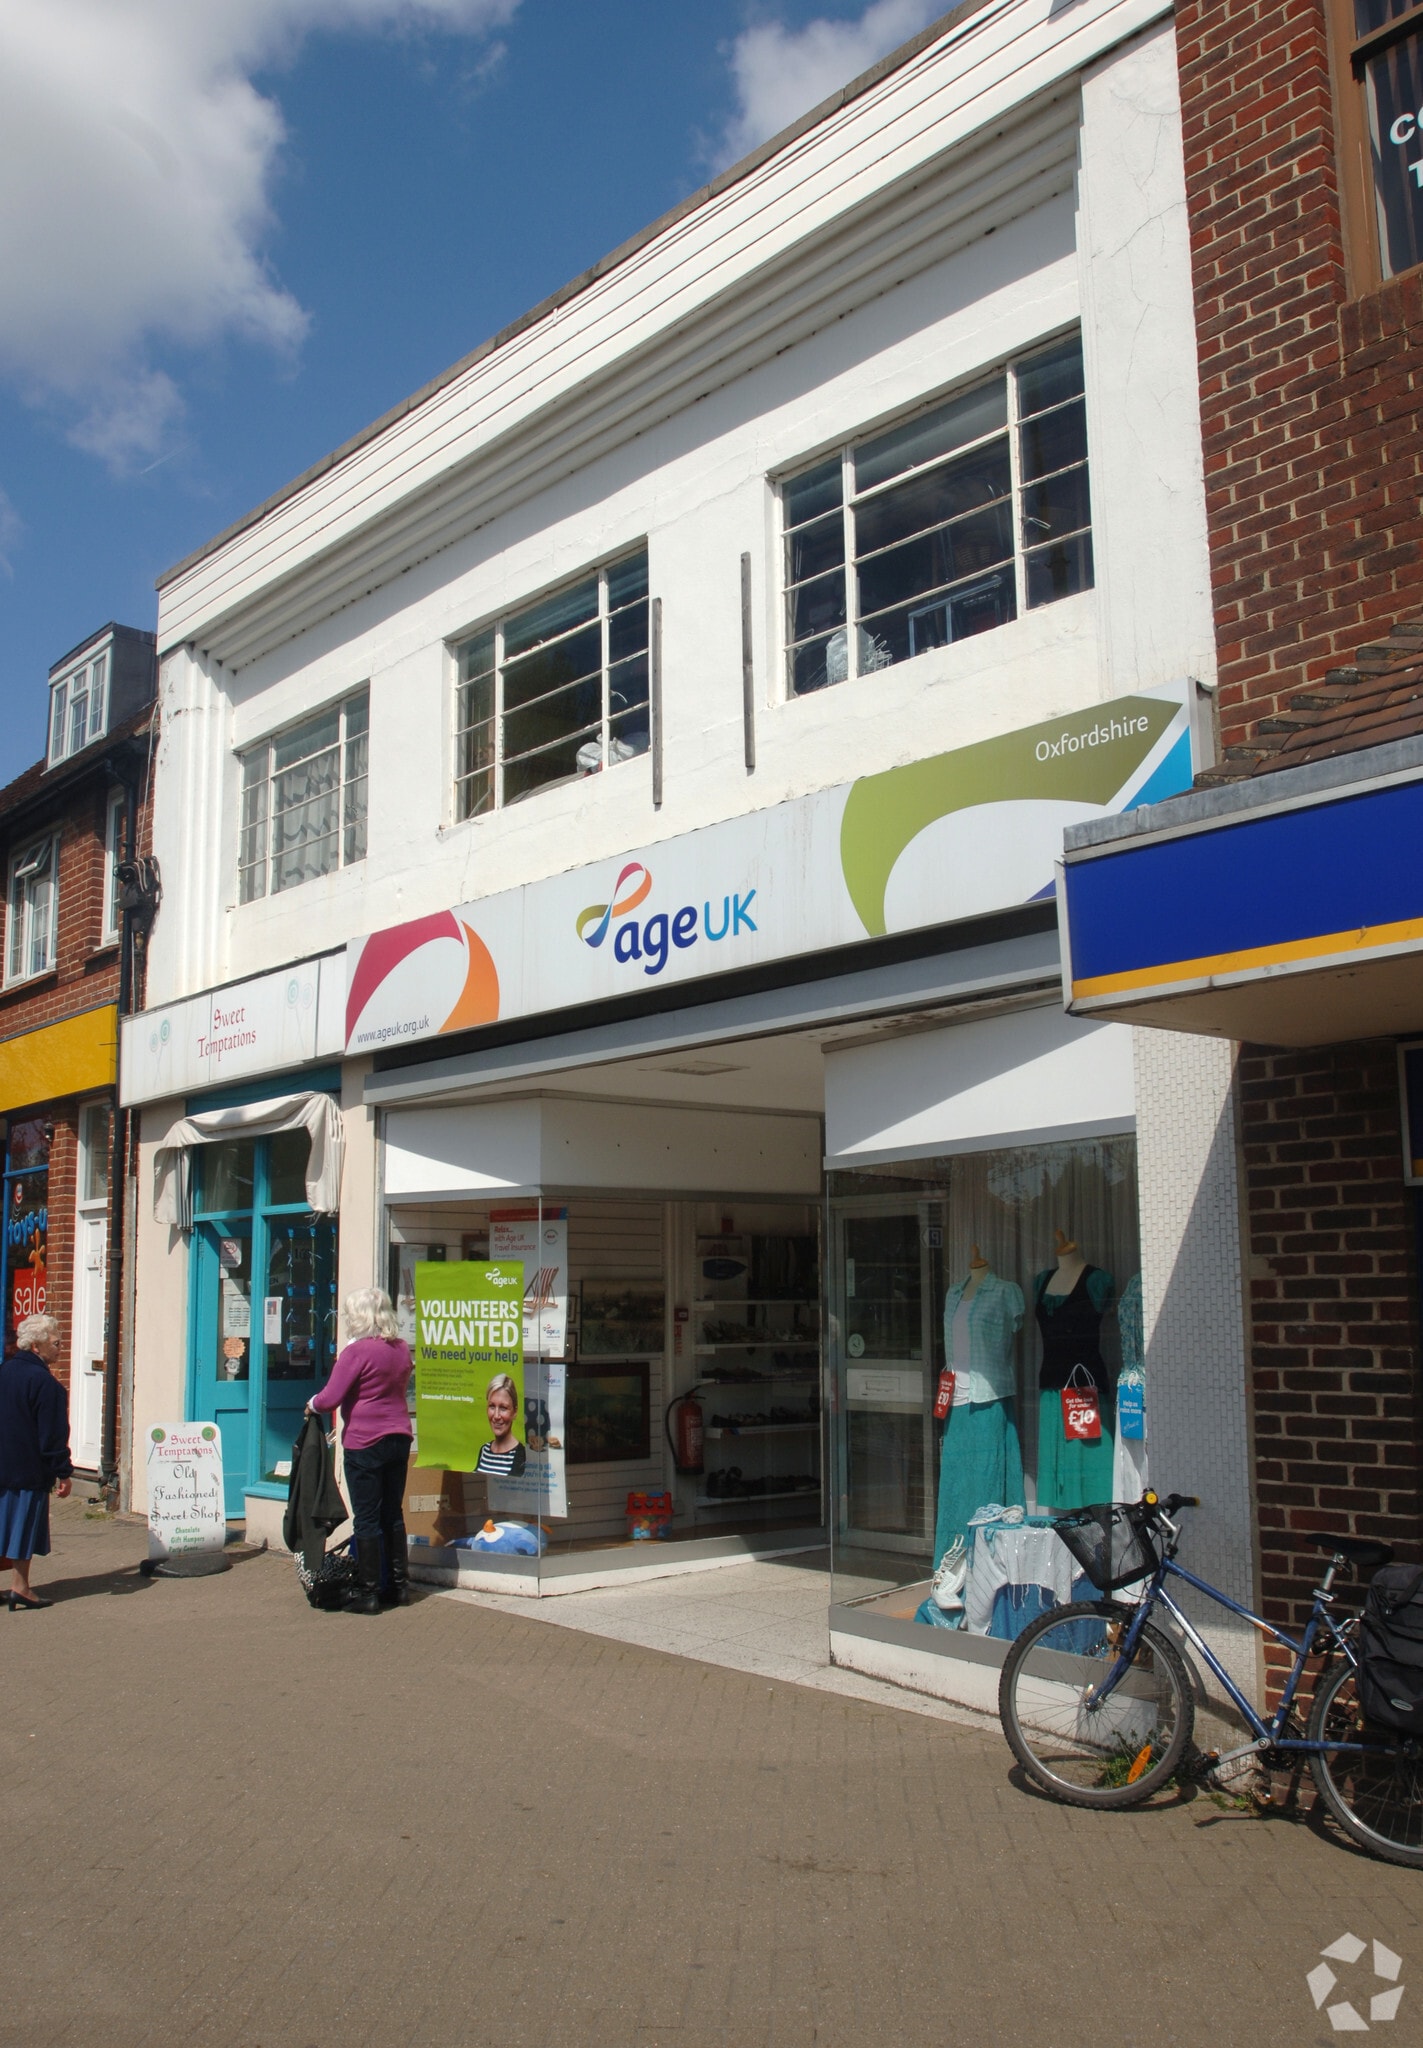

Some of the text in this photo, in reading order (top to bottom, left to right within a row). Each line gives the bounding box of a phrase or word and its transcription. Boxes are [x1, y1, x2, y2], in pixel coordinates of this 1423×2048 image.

[1035, 715, 1149, 762] Oxfordshire
[213, 1006, 246, 1031] Sweet
[357, 1015, 430, 1043] www.ageuk.org.uk
[197, 1028, 257, 1062] Temptations
[14, 1278, 47, 1316] sale
[420, 1299, 519, 1319] VOLUNTEERS
[420, 1319, 519, 1348] WANTED
[421, 1347, 519, 1366] We need your help
[1068, 1409, 1096, 1426] £10
[170, 1434, 201, 1445] Sweet
[156, 1446, 213, 1459] Temptations
[173, 1464, 197, 1479] Old
[154, 1485, 216, 1501] Fashioned
[150, 1504, 221, 1523] Sweet Shop
